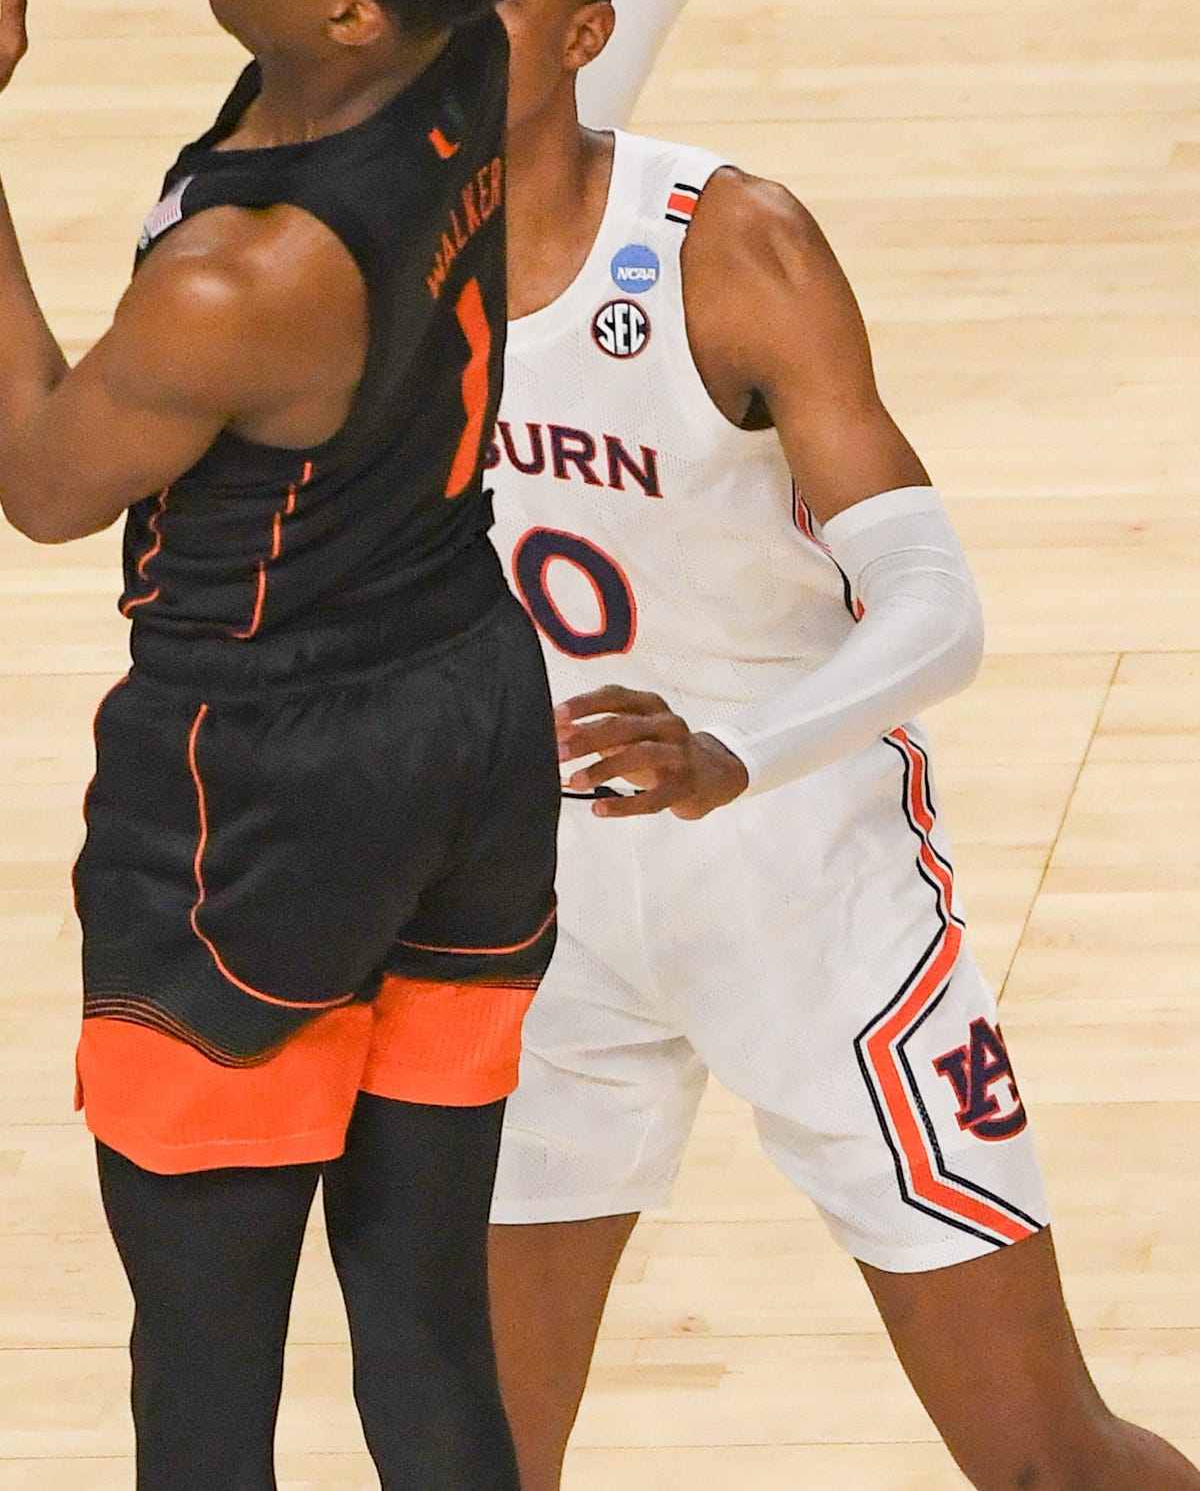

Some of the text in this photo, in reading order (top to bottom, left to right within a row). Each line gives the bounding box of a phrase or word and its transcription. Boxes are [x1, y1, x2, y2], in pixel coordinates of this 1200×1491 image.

[616, 266, 657, 281] NCAA
[594, 301, 647, 357] SEC
[444, 277, 492, 499] 1
